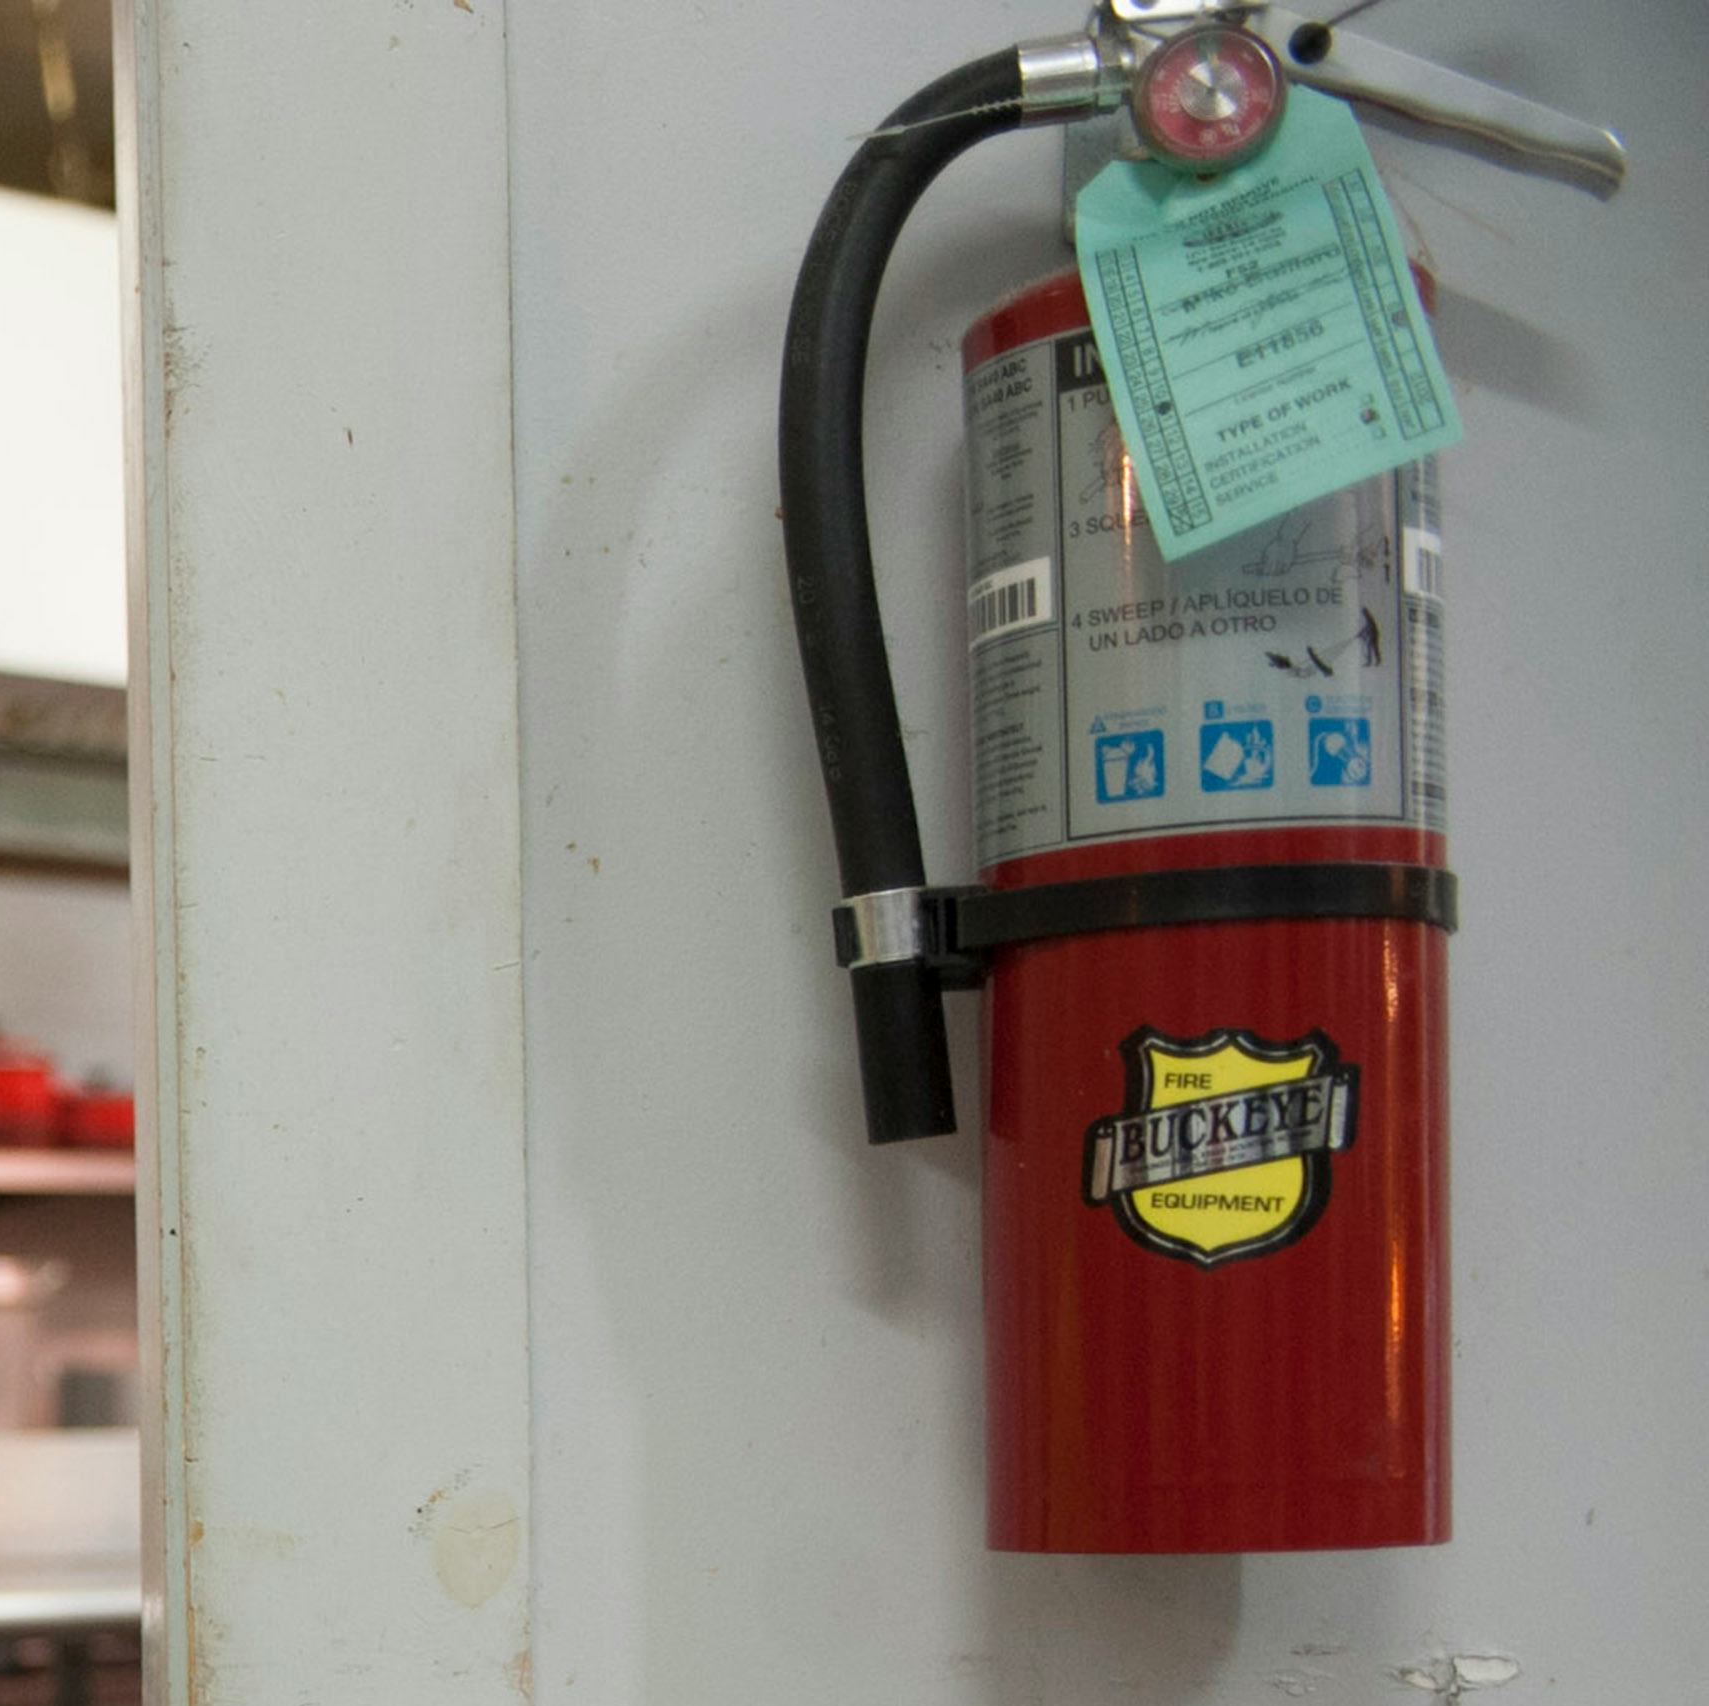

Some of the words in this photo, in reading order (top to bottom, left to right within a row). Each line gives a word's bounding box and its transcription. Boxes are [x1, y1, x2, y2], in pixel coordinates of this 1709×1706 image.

[1216, 414, 1264, 444] TYPE
[1265, 401, 1293, 422] OF
[1293, 376, 1352, 410] WORK
[1203, 420, 1308, 473] INSTALLATION
[1208, 433, 1321, 489] CERTIFICATION
[1214, 471, 1279, 506] SERVICE
[1069, 521, 1080, 538] 3
[1072, 613, 1081, 629] 4
[1088, 599, 1164, 627] SWEEP
[1316, 587, 1343, 605] DE
[1089, 632, 1118, 652] UN
[1124, 622, 1183, 645] LADO
[1191, 619, 1206, 638] A
[1211, 614, 1277, 635] OTRO
[1164, 1072, 1213, 1090] FIRE
[1119, 1084, 1325, 1167] BUCKEYE
[1151, 1192, 1285, 1213] EQUIPMENT
